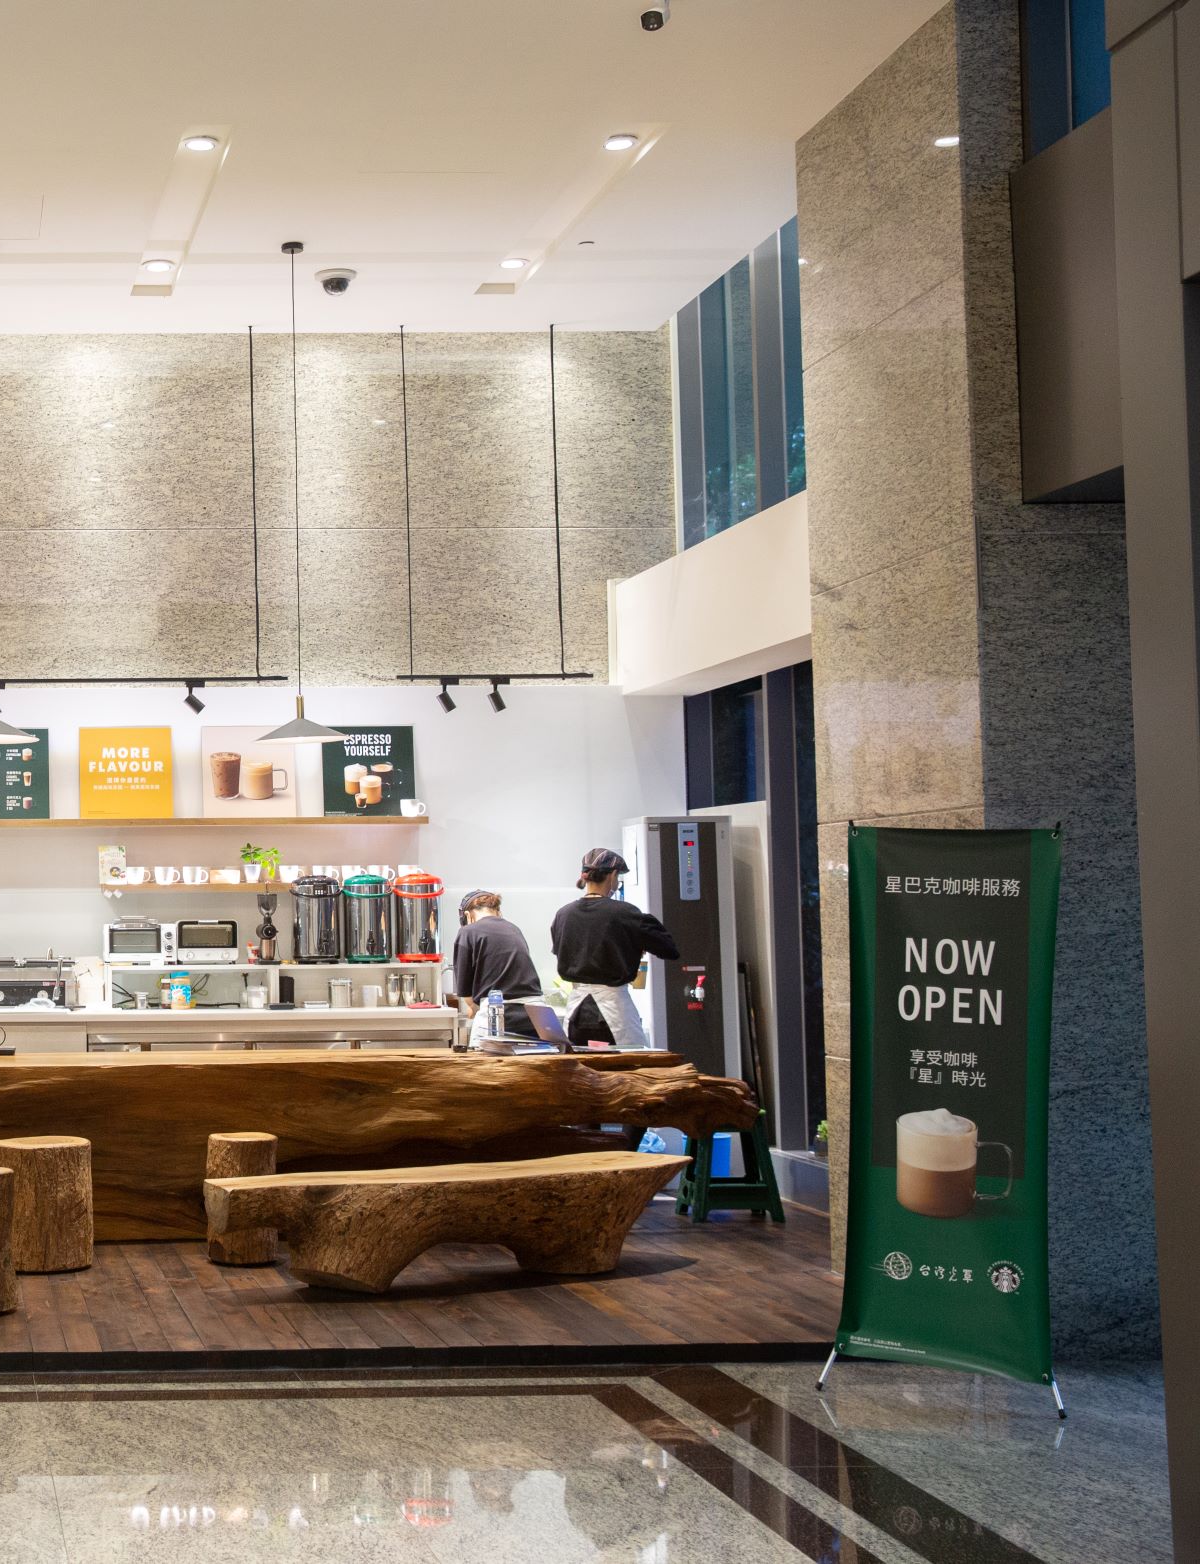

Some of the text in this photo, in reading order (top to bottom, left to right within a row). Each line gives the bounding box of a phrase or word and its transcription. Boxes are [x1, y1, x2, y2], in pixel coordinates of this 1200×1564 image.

[102, 747, 150, 758] MORE
[344, 746, 391, 756] YOURSELF
[88, 761, 164, 772] FLAVOUR
[884, 876, 1020, 897] 星巴克咖啡服務
[904, 937, 996, 976] NOW
[898, 984, 1003, 1026] OPEN
[910, 1049, 978, 1068] 享受咖啡
